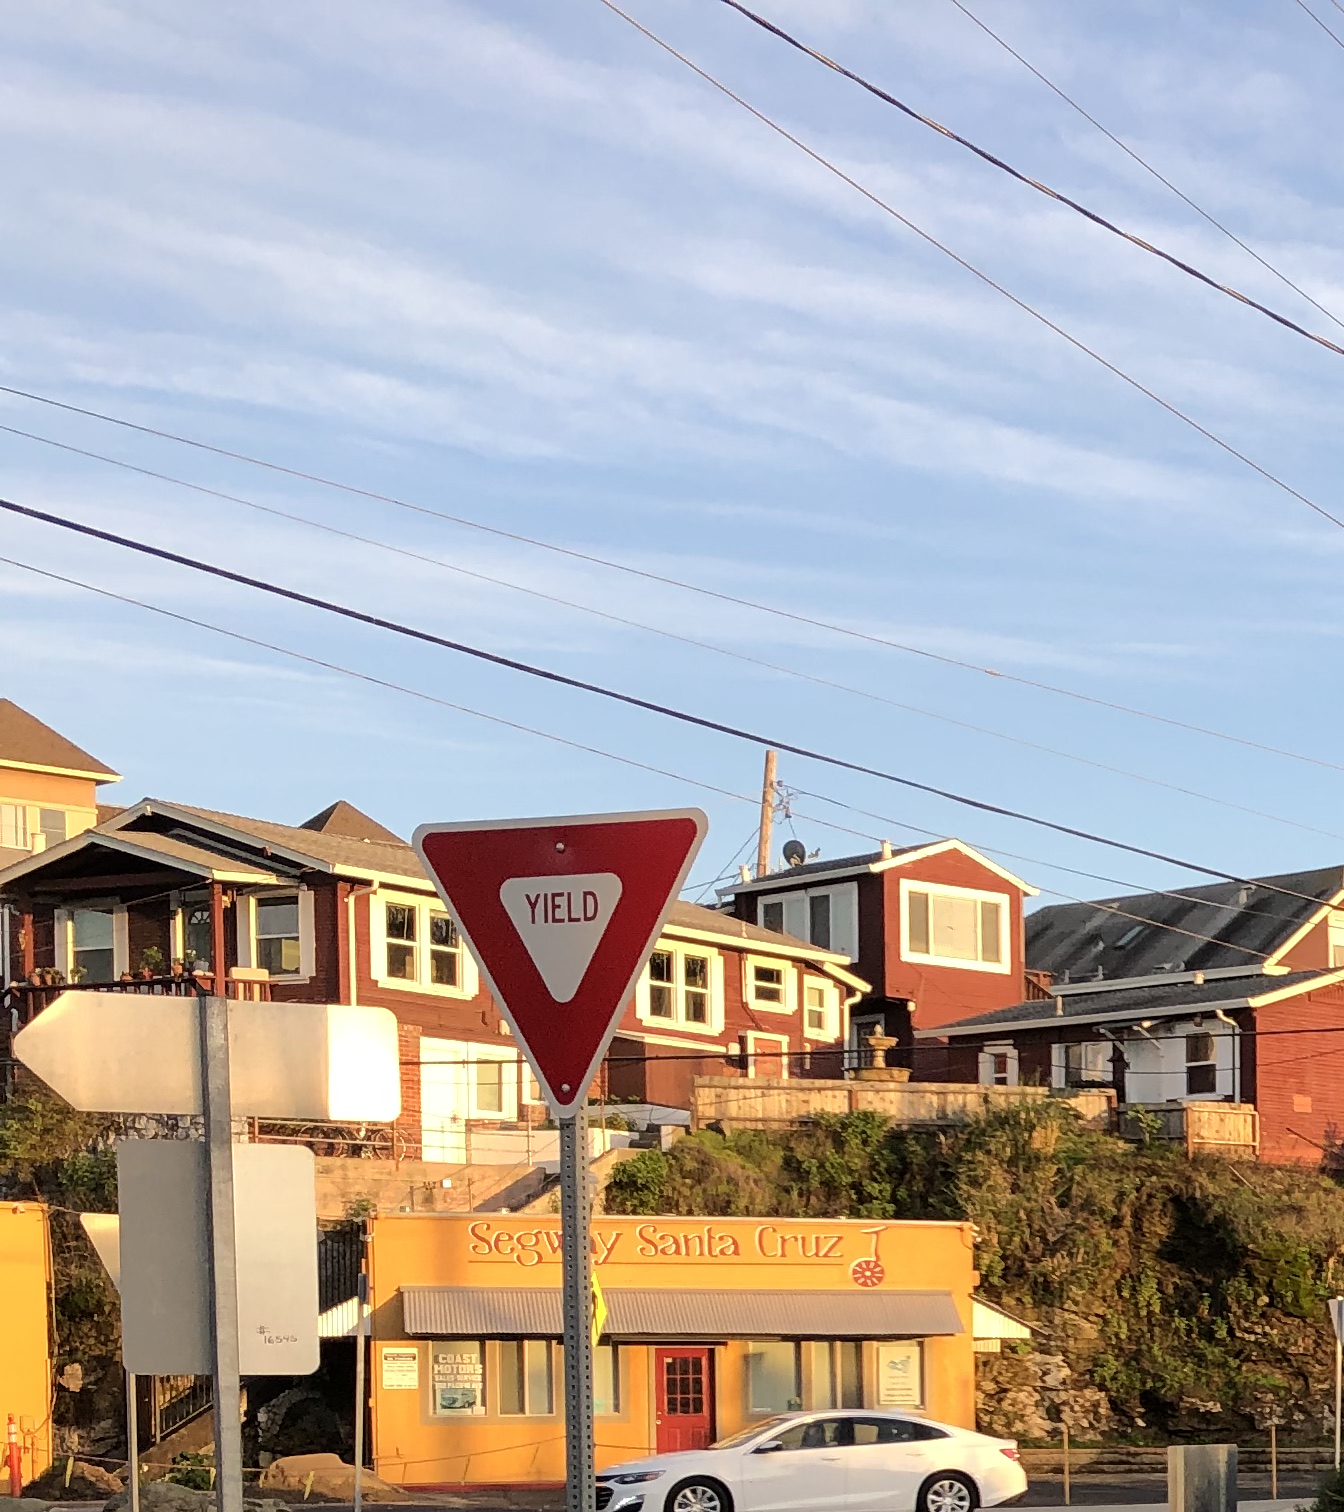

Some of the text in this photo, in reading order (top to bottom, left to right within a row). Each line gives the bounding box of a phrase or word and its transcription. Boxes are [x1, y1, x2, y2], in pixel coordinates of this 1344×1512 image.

[524, 890, 599, 925] YIELD
[636, 1223, 741, 1258] Santa
[755, 1224, 844, 1258] Cruz
[433, 1364, 483, 1374] MOTORS
[438, 1353, 478, 1364] COAST
